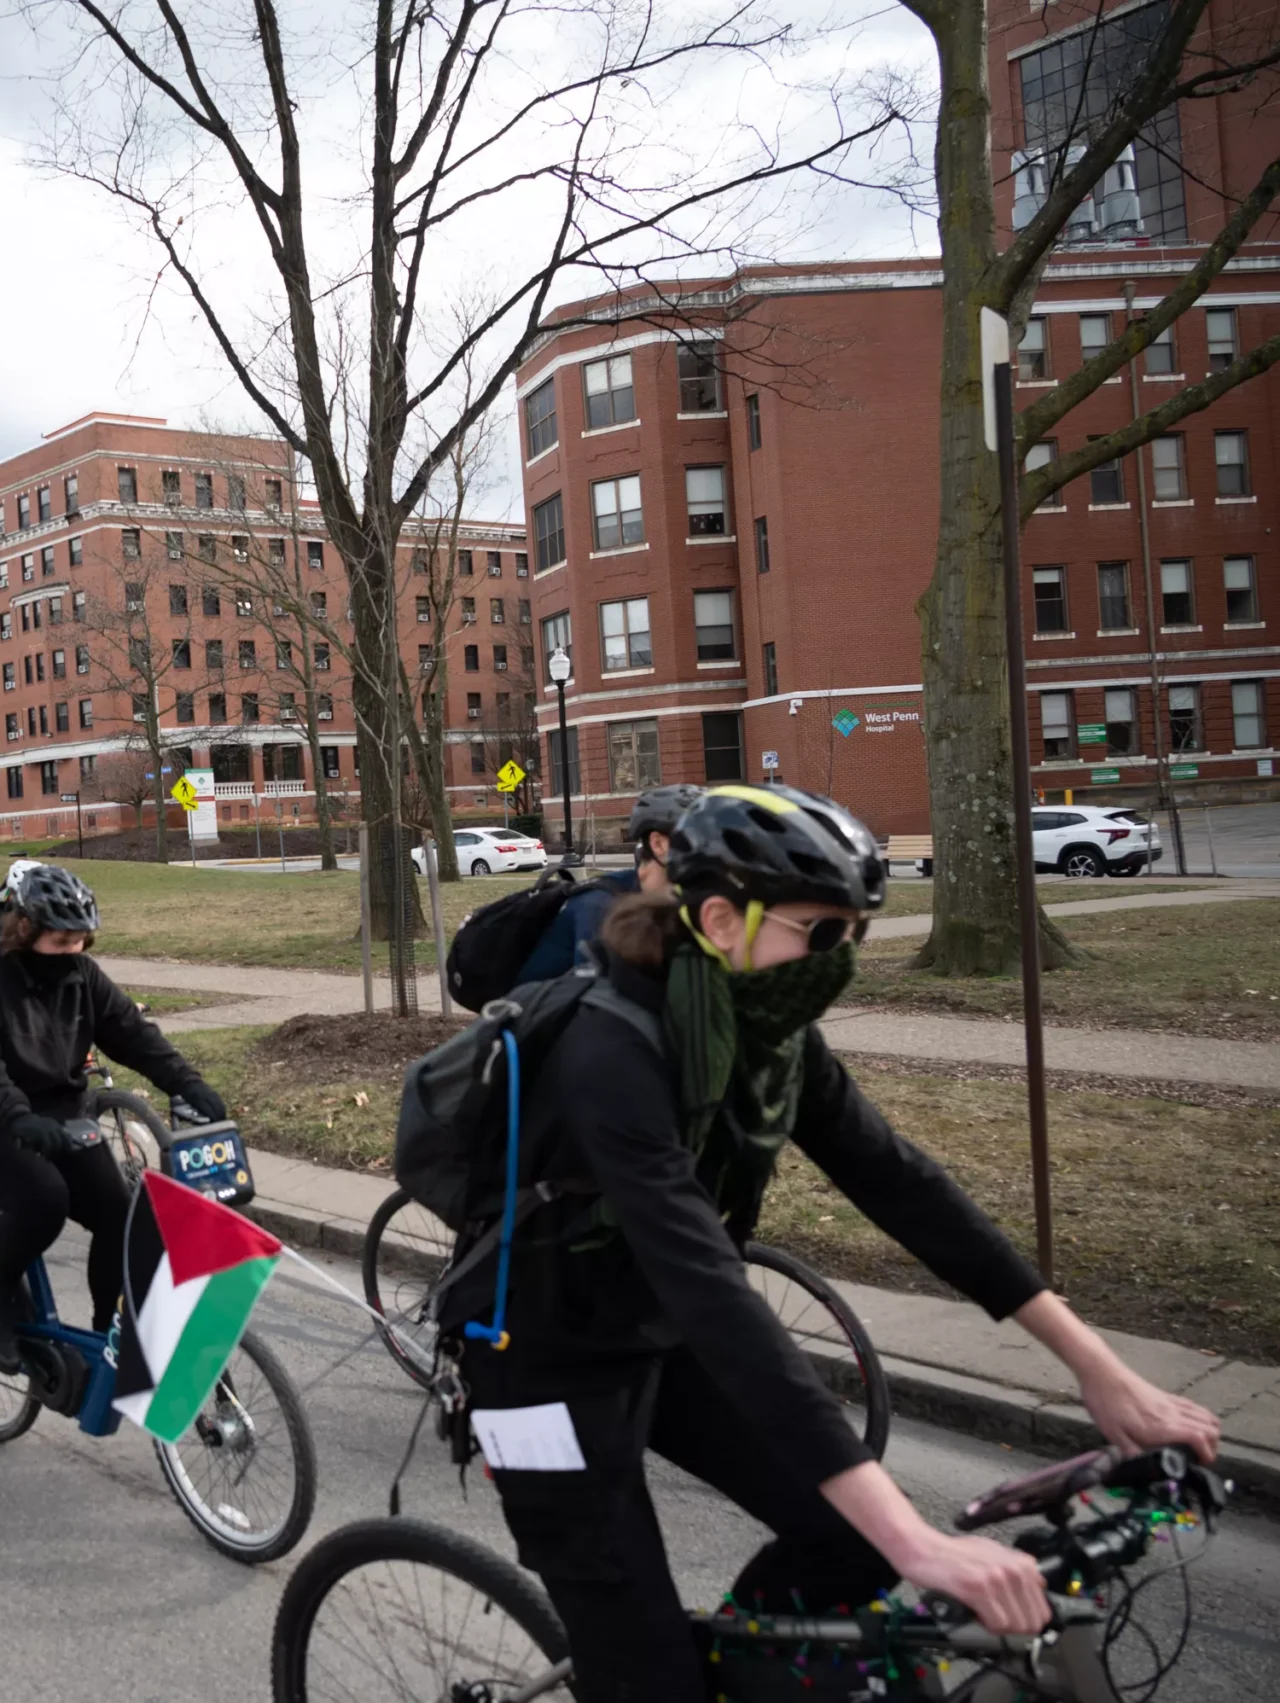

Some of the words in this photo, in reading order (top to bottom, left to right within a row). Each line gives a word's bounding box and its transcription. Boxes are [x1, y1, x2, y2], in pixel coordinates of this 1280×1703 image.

[865, 713, 891, 722] West
[893, 711, 919, 721] Penn
[865, 724, 894, 732] Hospital
[179, 1140, 236, 1171] POGOH
